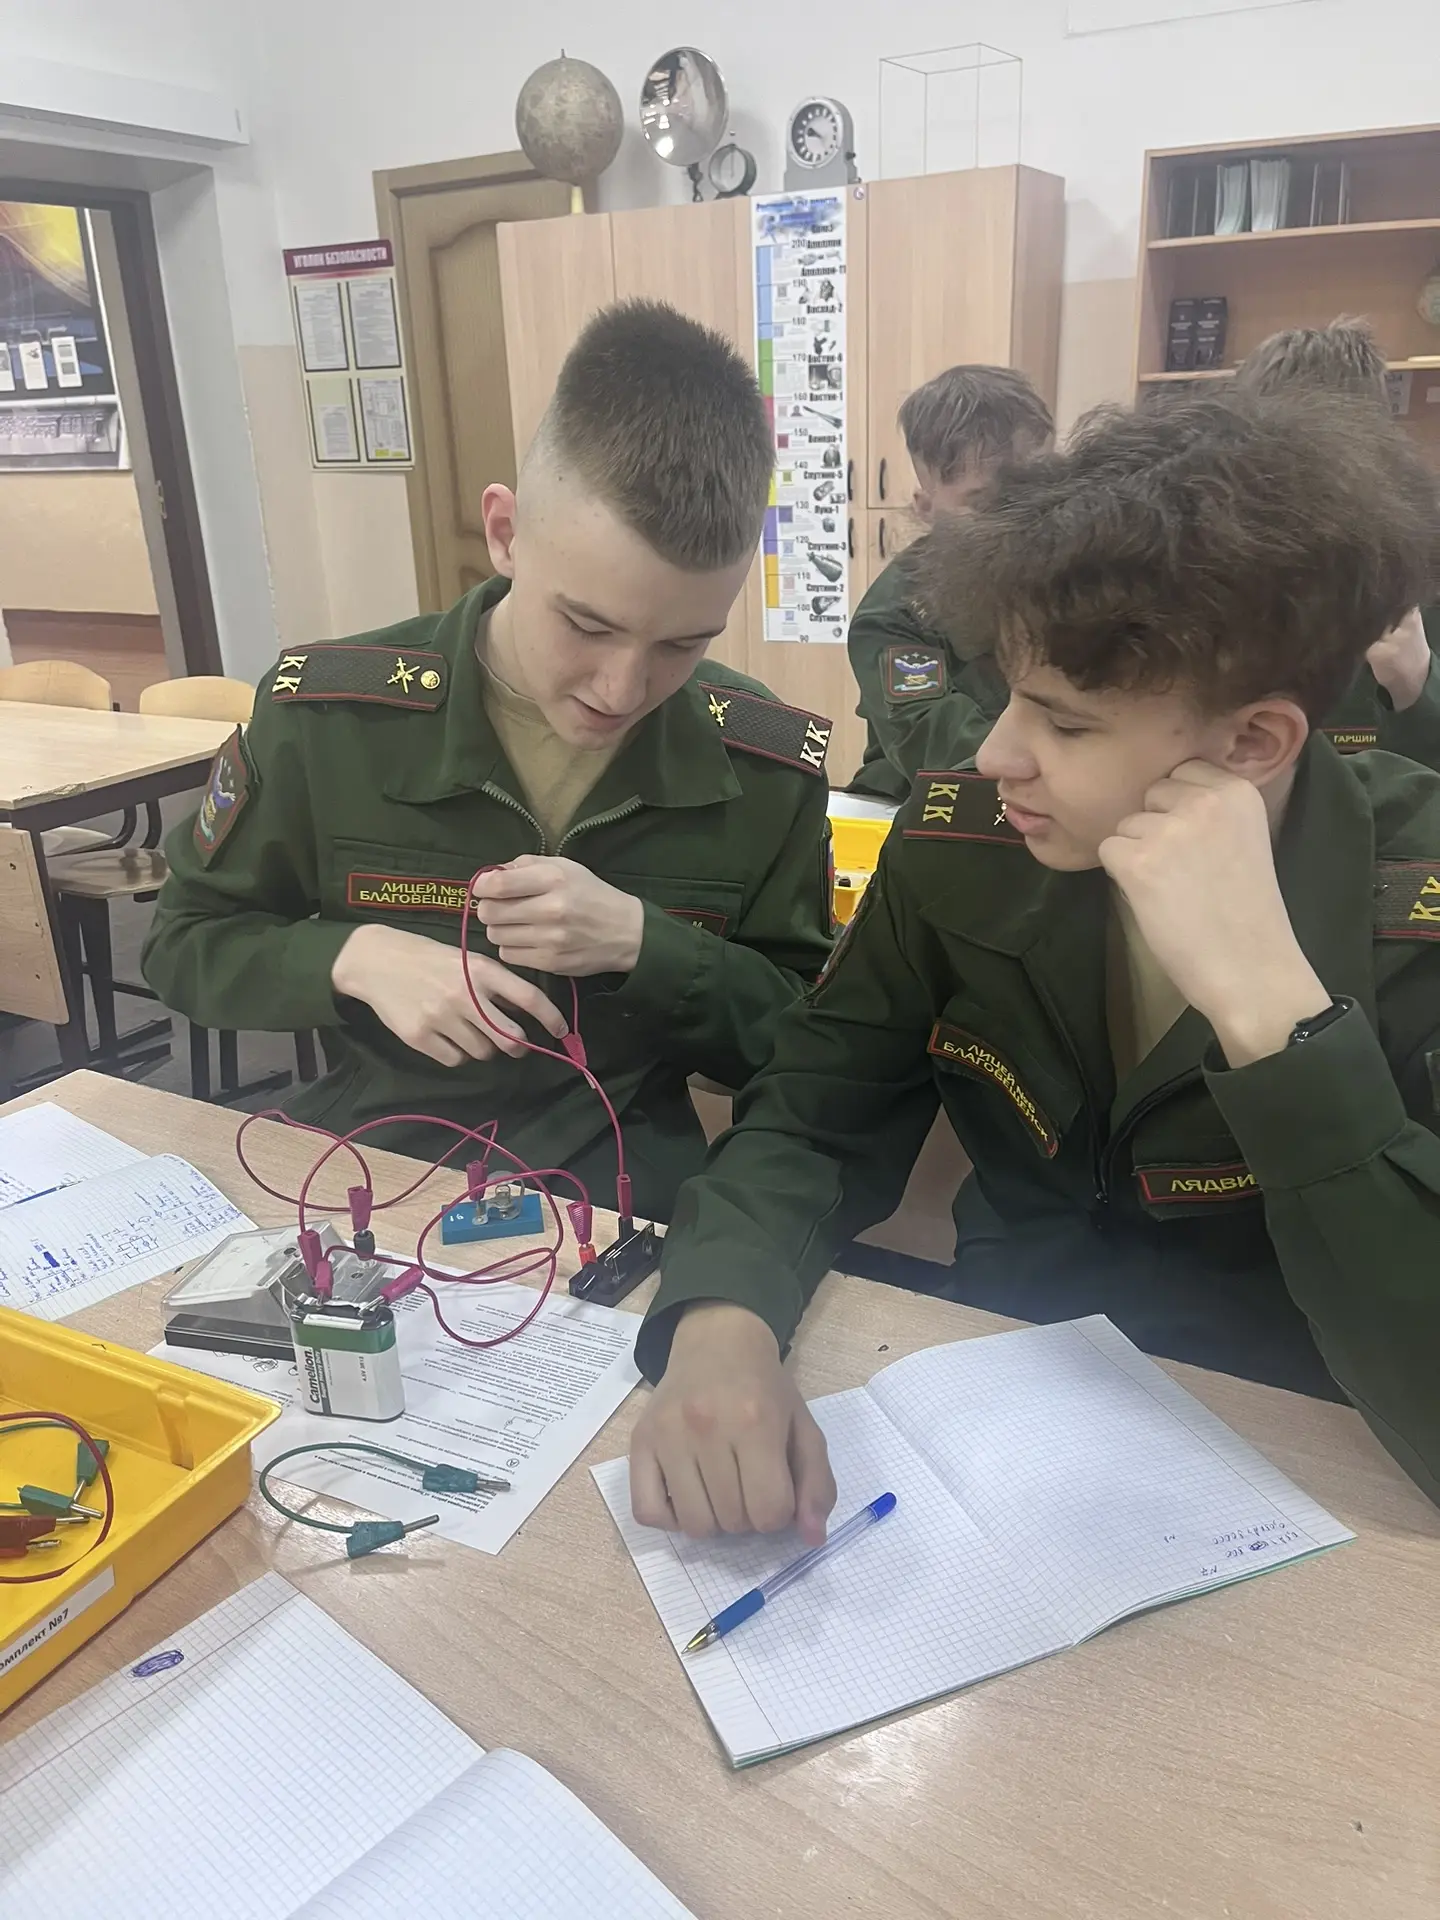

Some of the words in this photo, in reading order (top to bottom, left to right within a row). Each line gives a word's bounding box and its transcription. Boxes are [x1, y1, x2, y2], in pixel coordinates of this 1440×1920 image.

[794, 428, 808, 437] 150
[794, 461, 808, 469] 140
[795, 501, 809, 509] 130
[795, 536, 809, 544] 120
[797, 572, 811, 580] 110
[800, 635, 809, 643] 90
[1333, 734, 1377, 744] ГАРШИН
[381, 882, 437, 895] ЛИЦЕЙ
[440, 885, 468, 897] №6
[360, 890, 478, 909] БЛАГОВЕЩЕНС
[968, 1044, 1016, 1086] ЛИЦЕЙ
[943, 1041, 1048, 1142] БЛАГОВЕЩЕНСК
[1171, 1173, 1258, 1193] ЛЯДВИ
[304, 1350, 320, 1404] Camelion
[0, 1628, 47, 1670] омплект
[48, 1607, 69, 1630] №7
